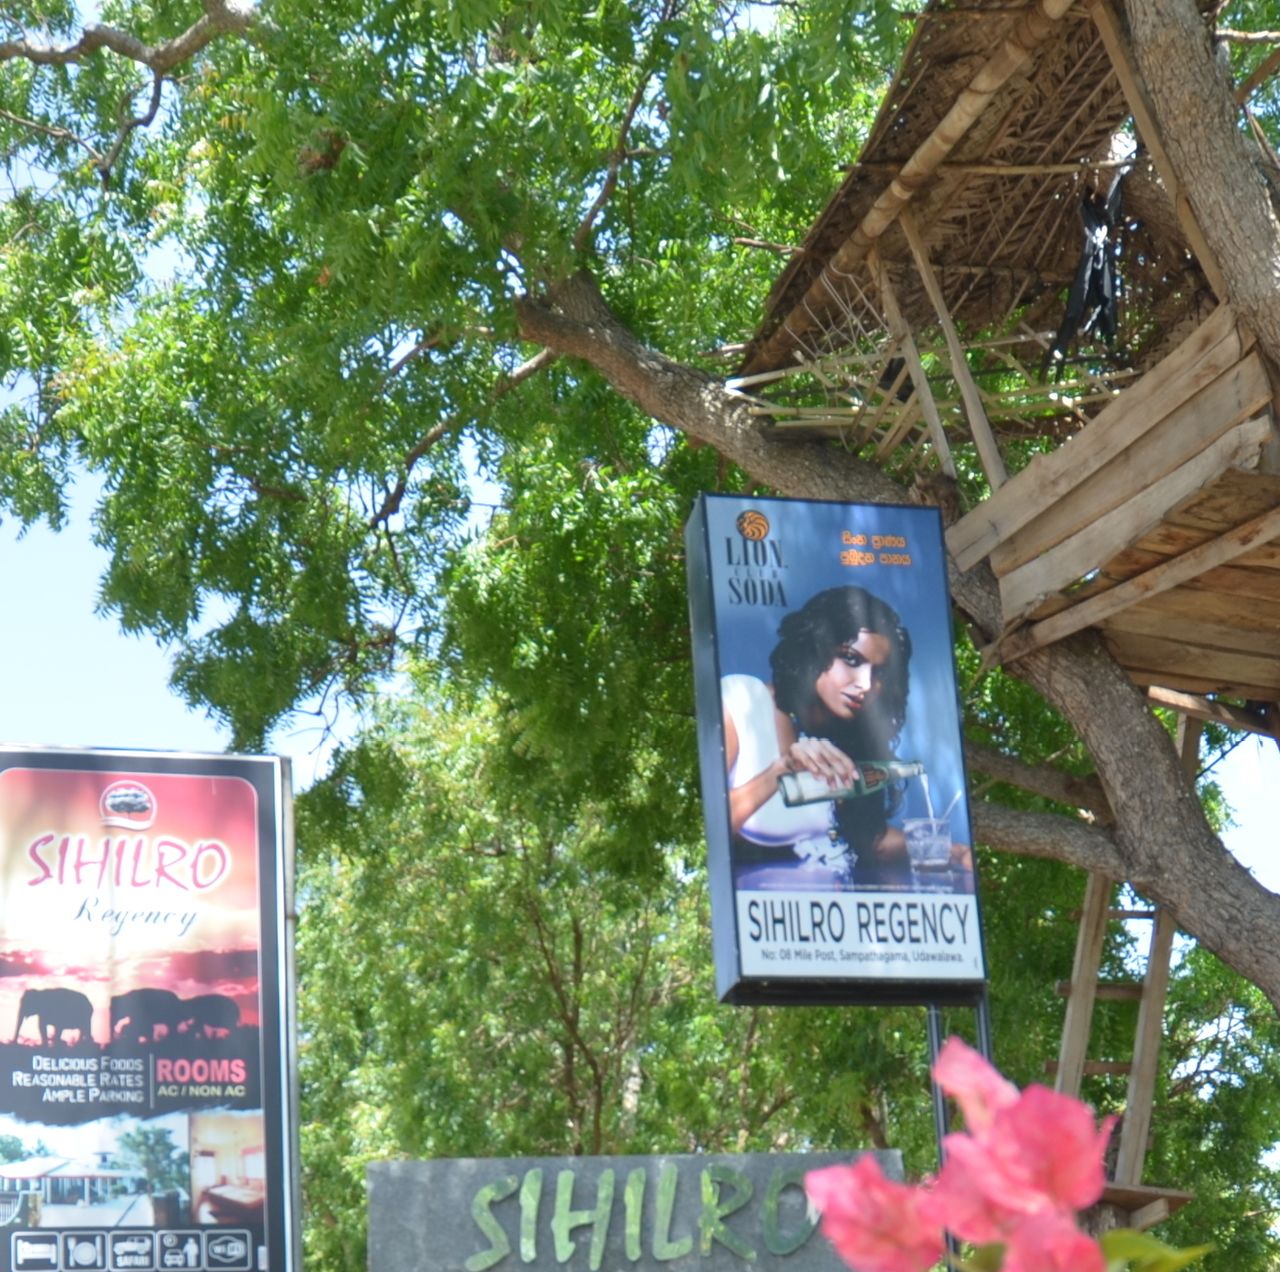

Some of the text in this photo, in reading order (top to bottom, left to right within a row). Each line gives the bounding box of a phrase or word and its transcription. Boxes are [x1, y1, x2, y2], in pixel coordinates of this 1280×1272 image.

[724, 537, 785, 568] LION
[728, 577, 788, 608] SODA
[27, 834, 227, 891] SIHILRO
[74, 896, 198, 937] Regency
[748, 899, 970, 945] SIHILRO REGENCY
[794, 950, 812, 961] Mile
[156, 1058, 247, 1083] ROOMS
[157, 1086, 177, 1097] AC
[188, 1086, 221, 1097] NON
[224, 1086, 246, 1097] AC
